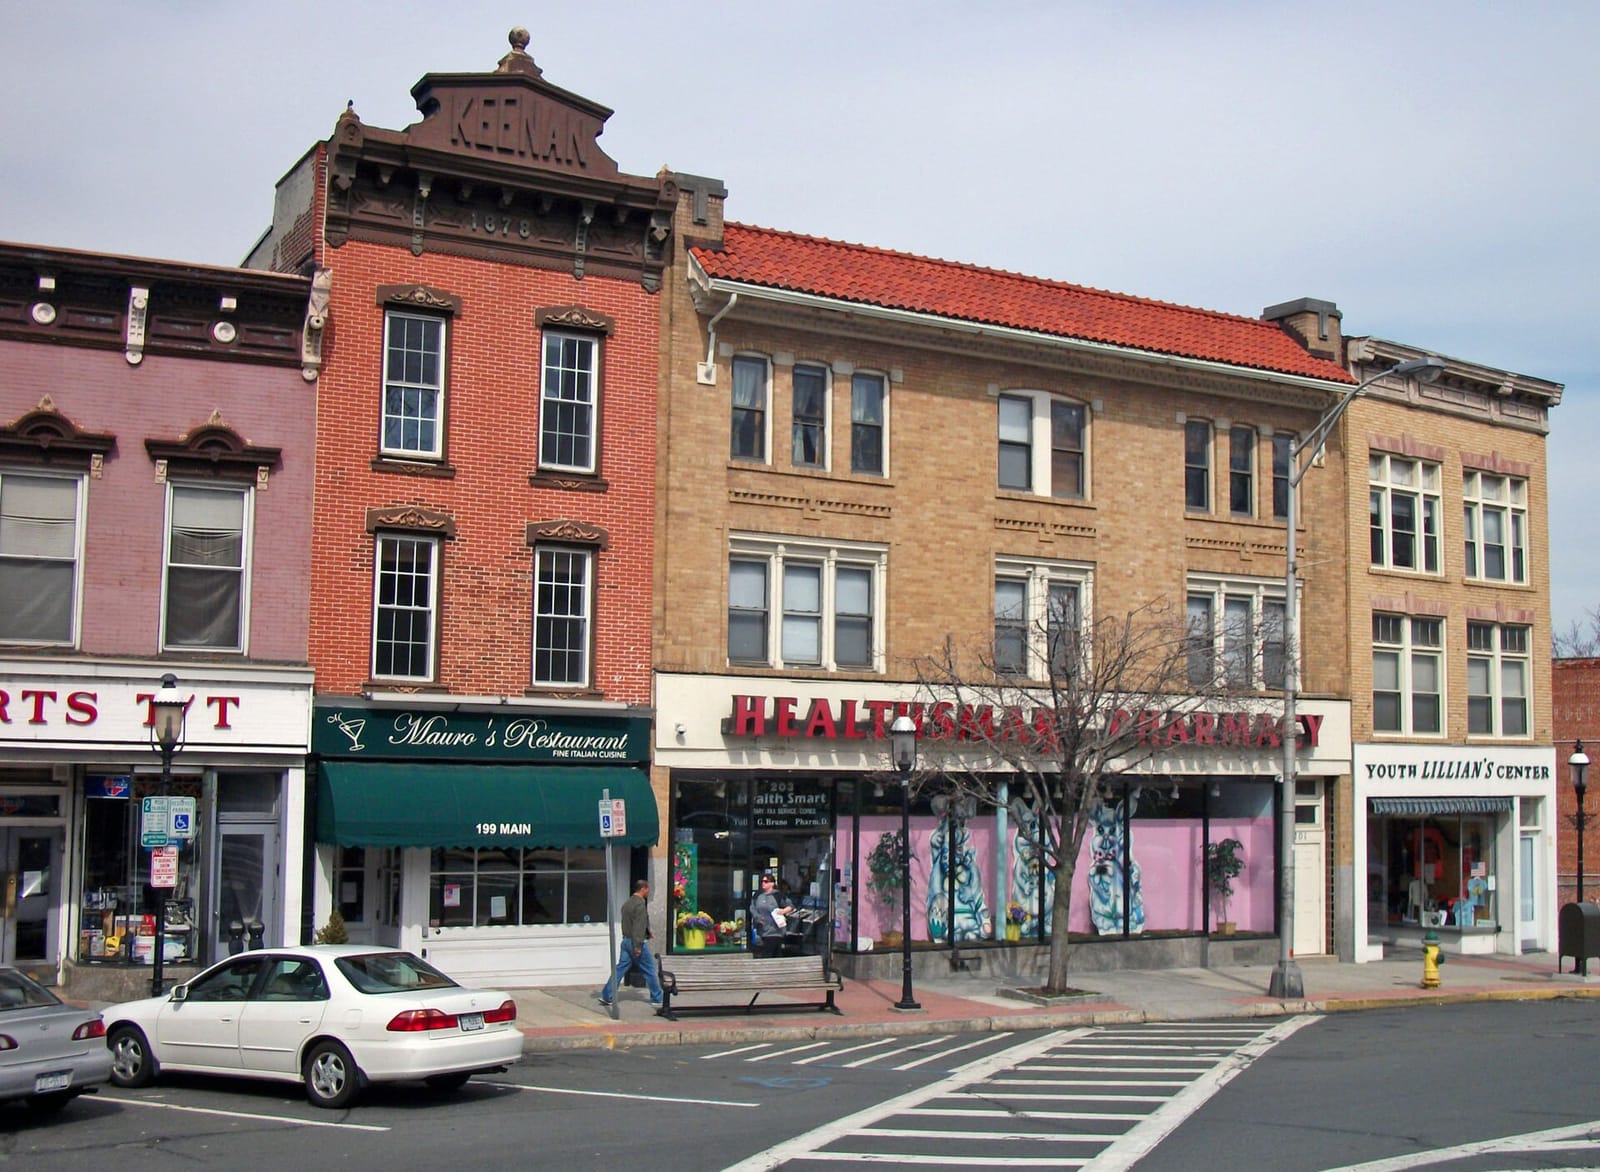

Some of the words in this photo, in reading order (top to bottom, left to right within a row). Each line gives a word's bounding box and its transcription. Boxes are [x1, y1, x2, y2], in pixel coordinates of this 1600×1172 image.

[450, 95, 586, 169] KEENAN
[471, 212, 531, 239] 1878
[503, 718, 628, 751] Restaurant
[552, 749, 569, 758] FINE
[570, 750, 598, 759] ITALIAN
[598, 750, 627, 760] CUISINE
[1365, 763, 1418, 780] YOUTH
[1421, 757, 1494, 780] LILLIAN'S
[1496, 765, 1549, 780] CENTER
[770, 782, 794, 792] 203
[737, 792, 783, 805] Halth
[787, 792, 827, 804] Smart
[475, 823, 497, 835] 199
[499, 823, 531, 836] MAIN
